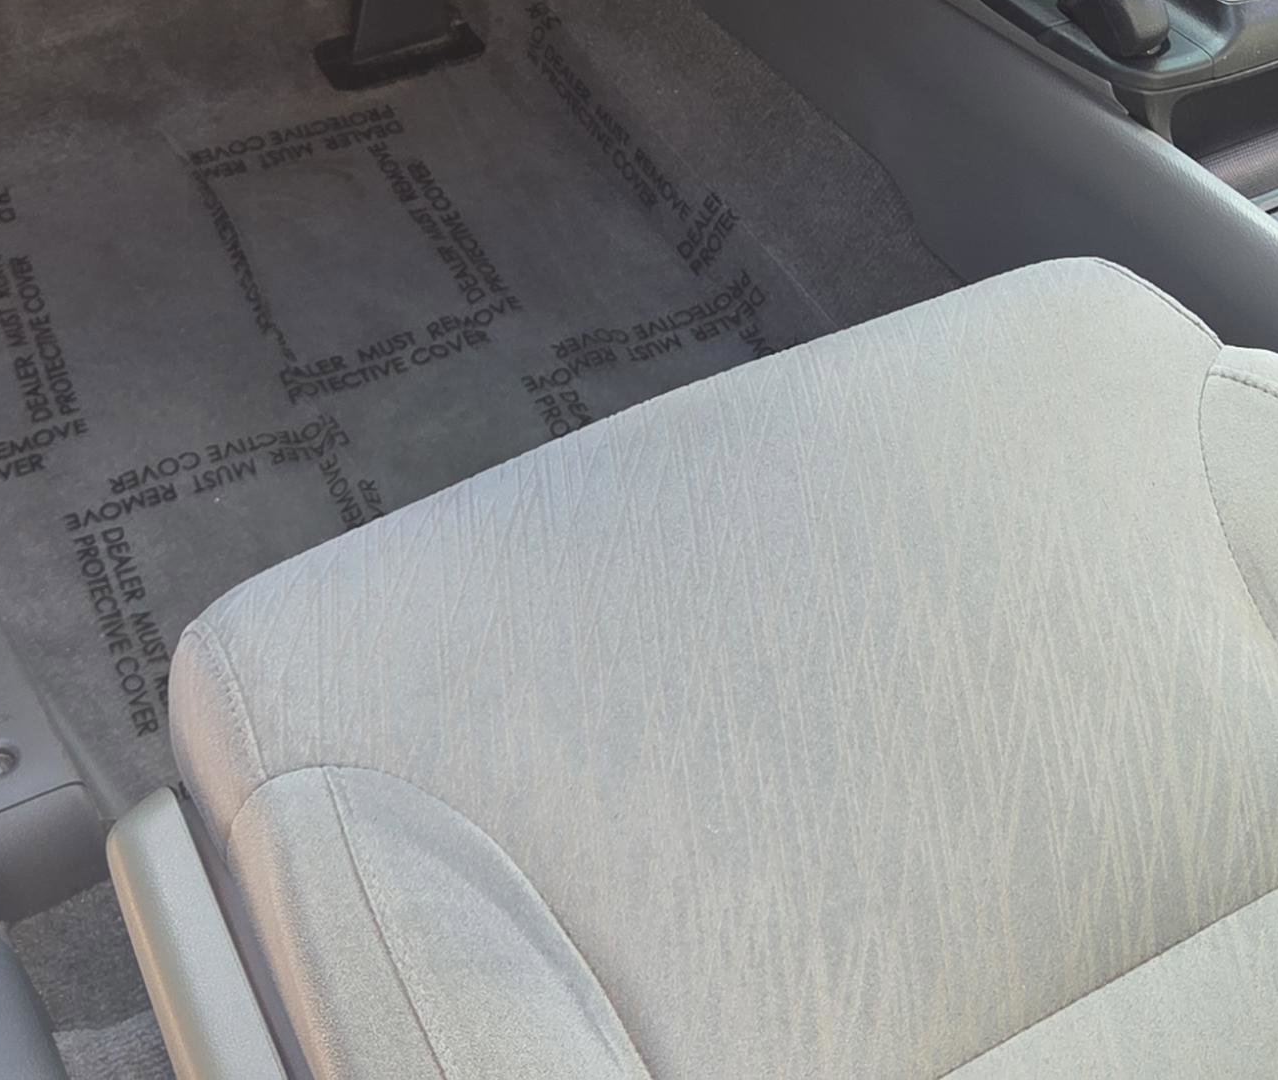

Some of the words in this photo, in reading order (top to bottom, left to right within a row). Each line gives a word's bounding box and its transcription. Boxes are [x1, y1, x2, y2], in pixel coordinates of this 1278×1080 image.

[268, 104, 396, 147] PROTECTIVE
[321, 120, 404, 151] DEALER
[258, 142, 313, 170] MUST
[8, 255, 45, 314] COVER
[631, 268, 751, 341] PROTECTIVE
[357, 330, 416, 364] MUST
[425, 295, 524, 341] REMOVE
[689, 284, 767, 342] DEALER
[28, 311, 81, 417] PROTECTIVE
[410, 328, 493, 366] COVER
[520, 344, 618, 394] REMOVE
[550, 328, 630, 360] COVER
[626, 332, 683, 363] MUST
[13, 352, 53, 423] DEALER
[106, 451, 202, 495] COVER
[191, 457, 258, 494] MUST
[63, 481, 179, 532] REMOVE
[101, 526, 147, 603] DEALER
[129, 610, 170, 664] MUST
[72, 533, 135, 655] PROTECTIVE
[115, 655, 160, 739] COVER
